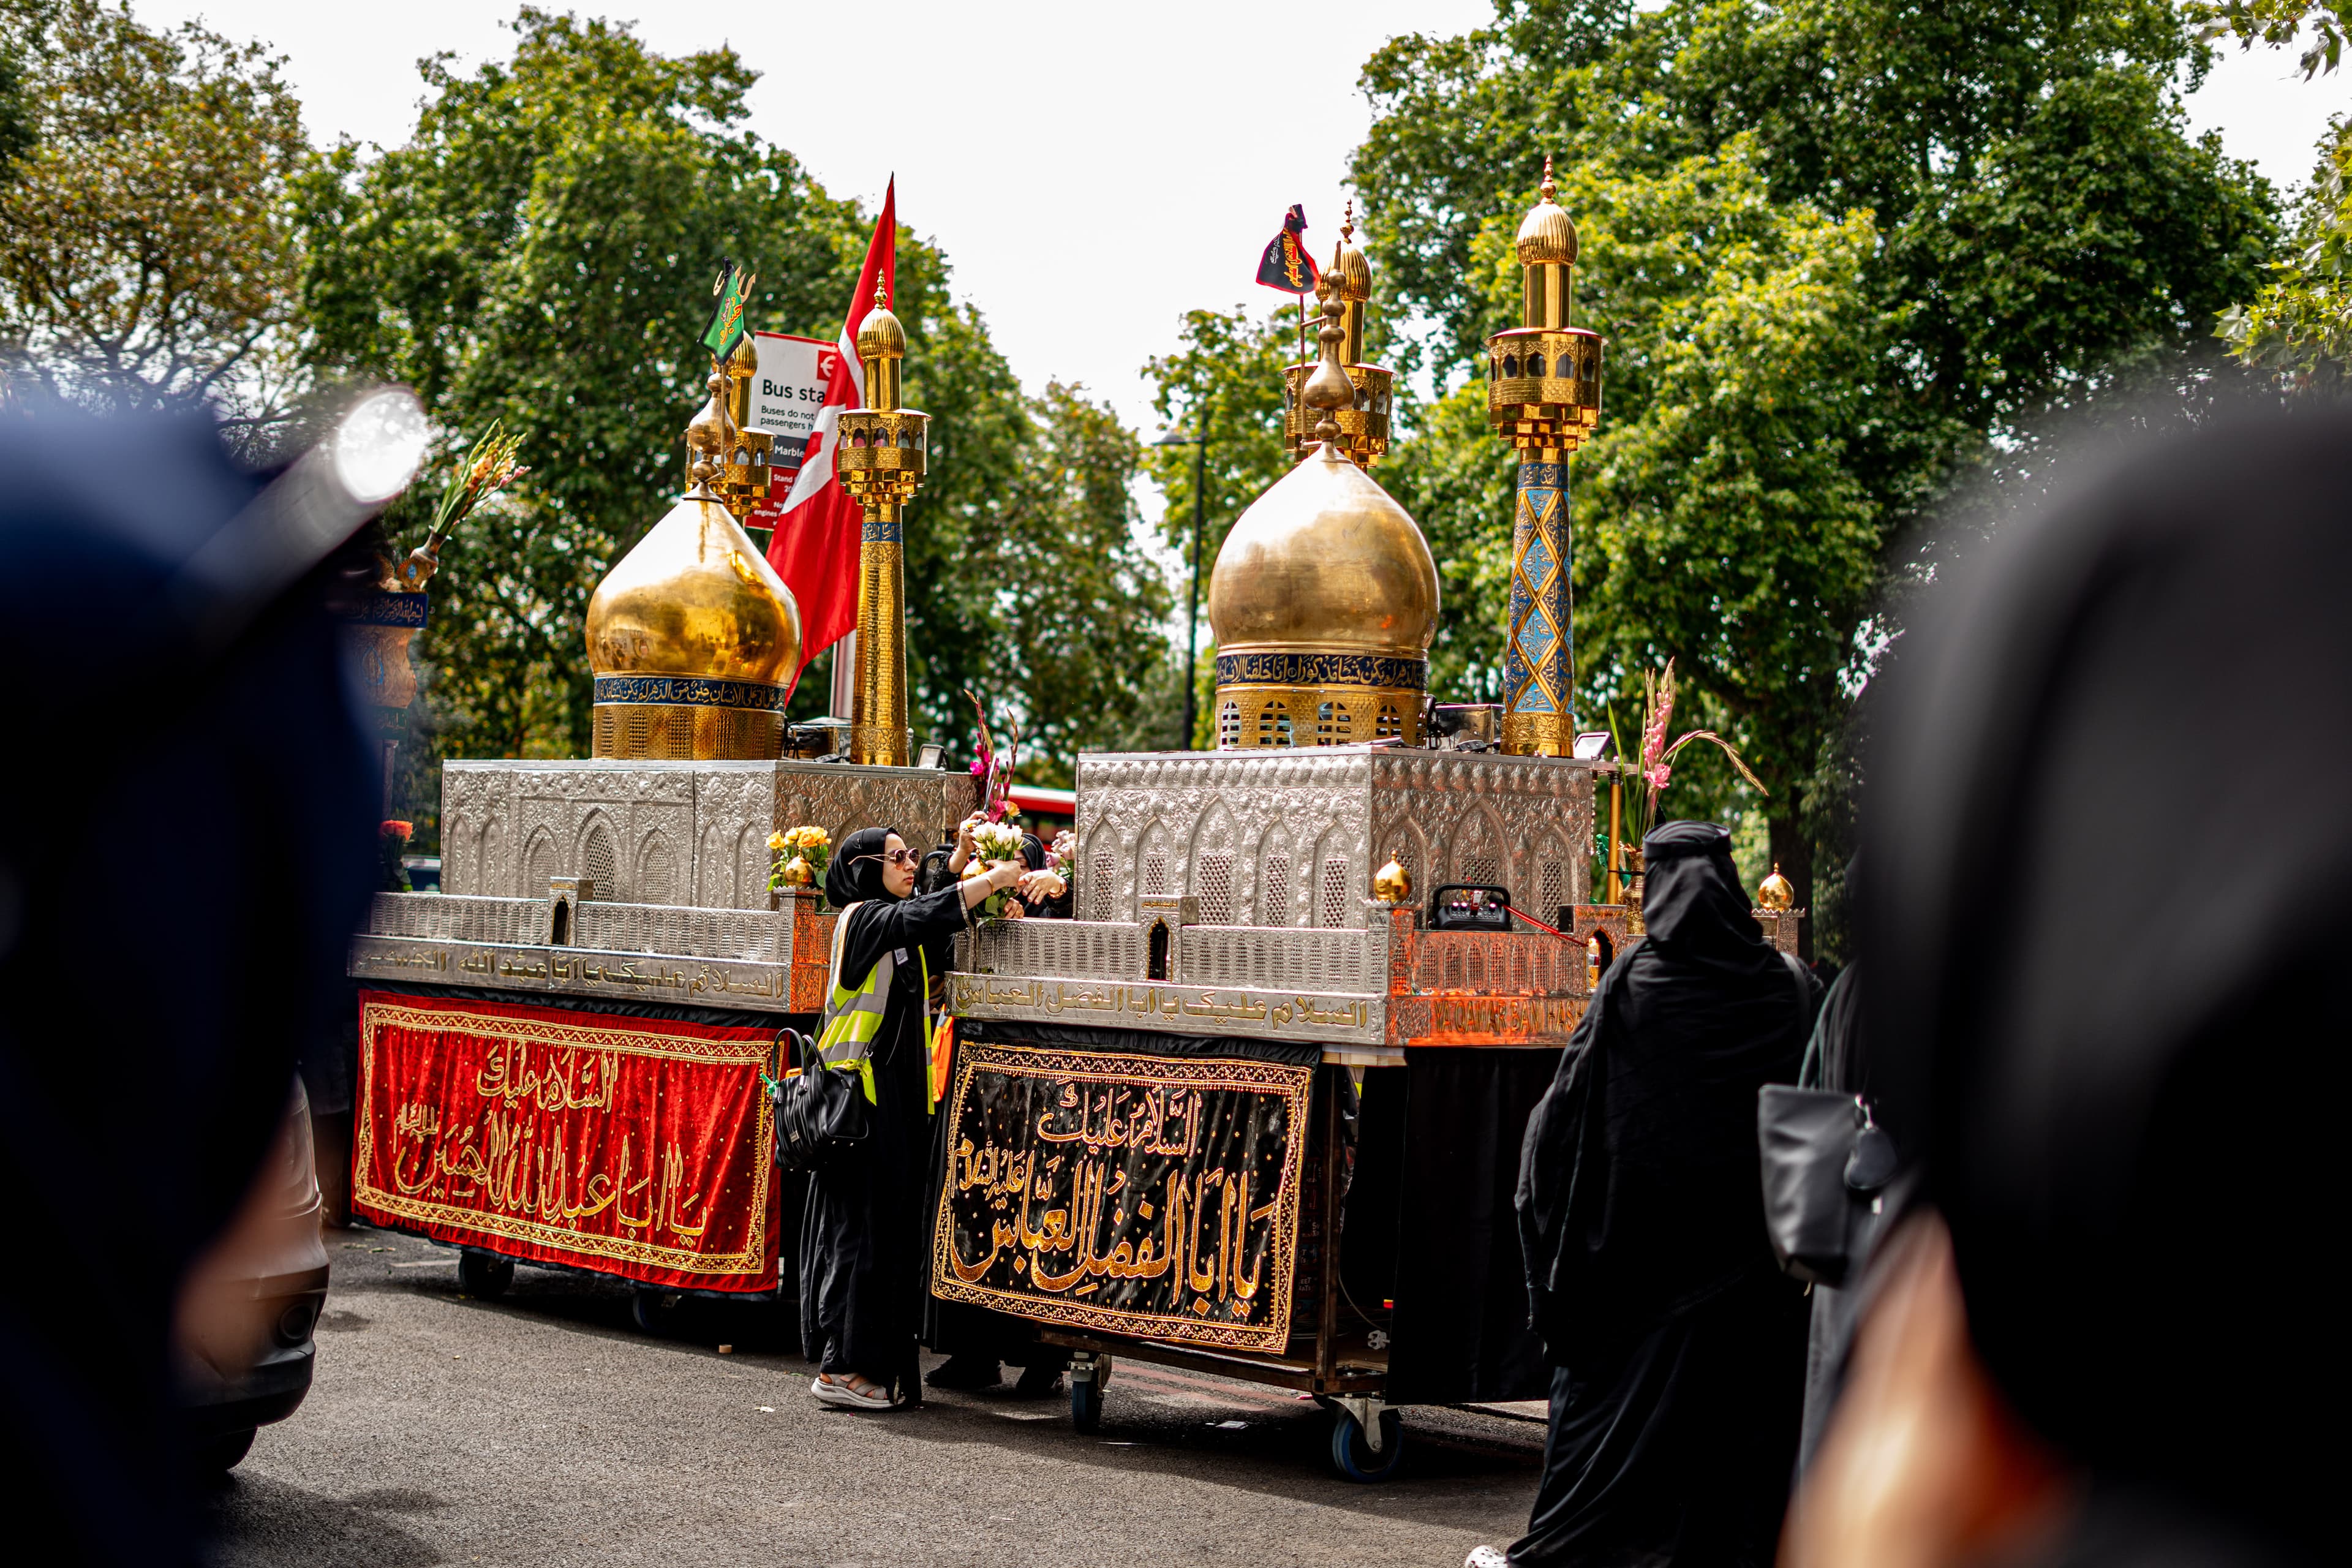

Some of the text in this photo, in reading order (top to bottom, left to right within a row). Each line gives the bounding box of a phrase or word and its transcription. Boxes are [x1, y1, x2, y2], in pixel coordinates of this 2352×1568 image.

[763, 379, 826, 403] Bus sta
[761, 405, 785, 417] Buses
[788, 410, 798, 418] do
[760, 418, 805, 430] passengers
[774, 445, 804, 458] Marble
[774, 474, 793, 483] Stand
[1046, 984, 1124, 1014] الفضل
[1272, 995, 1368, 1030] السلام
[1434, 1000, 1589, 1035] YA QAMAR BANI HASH
